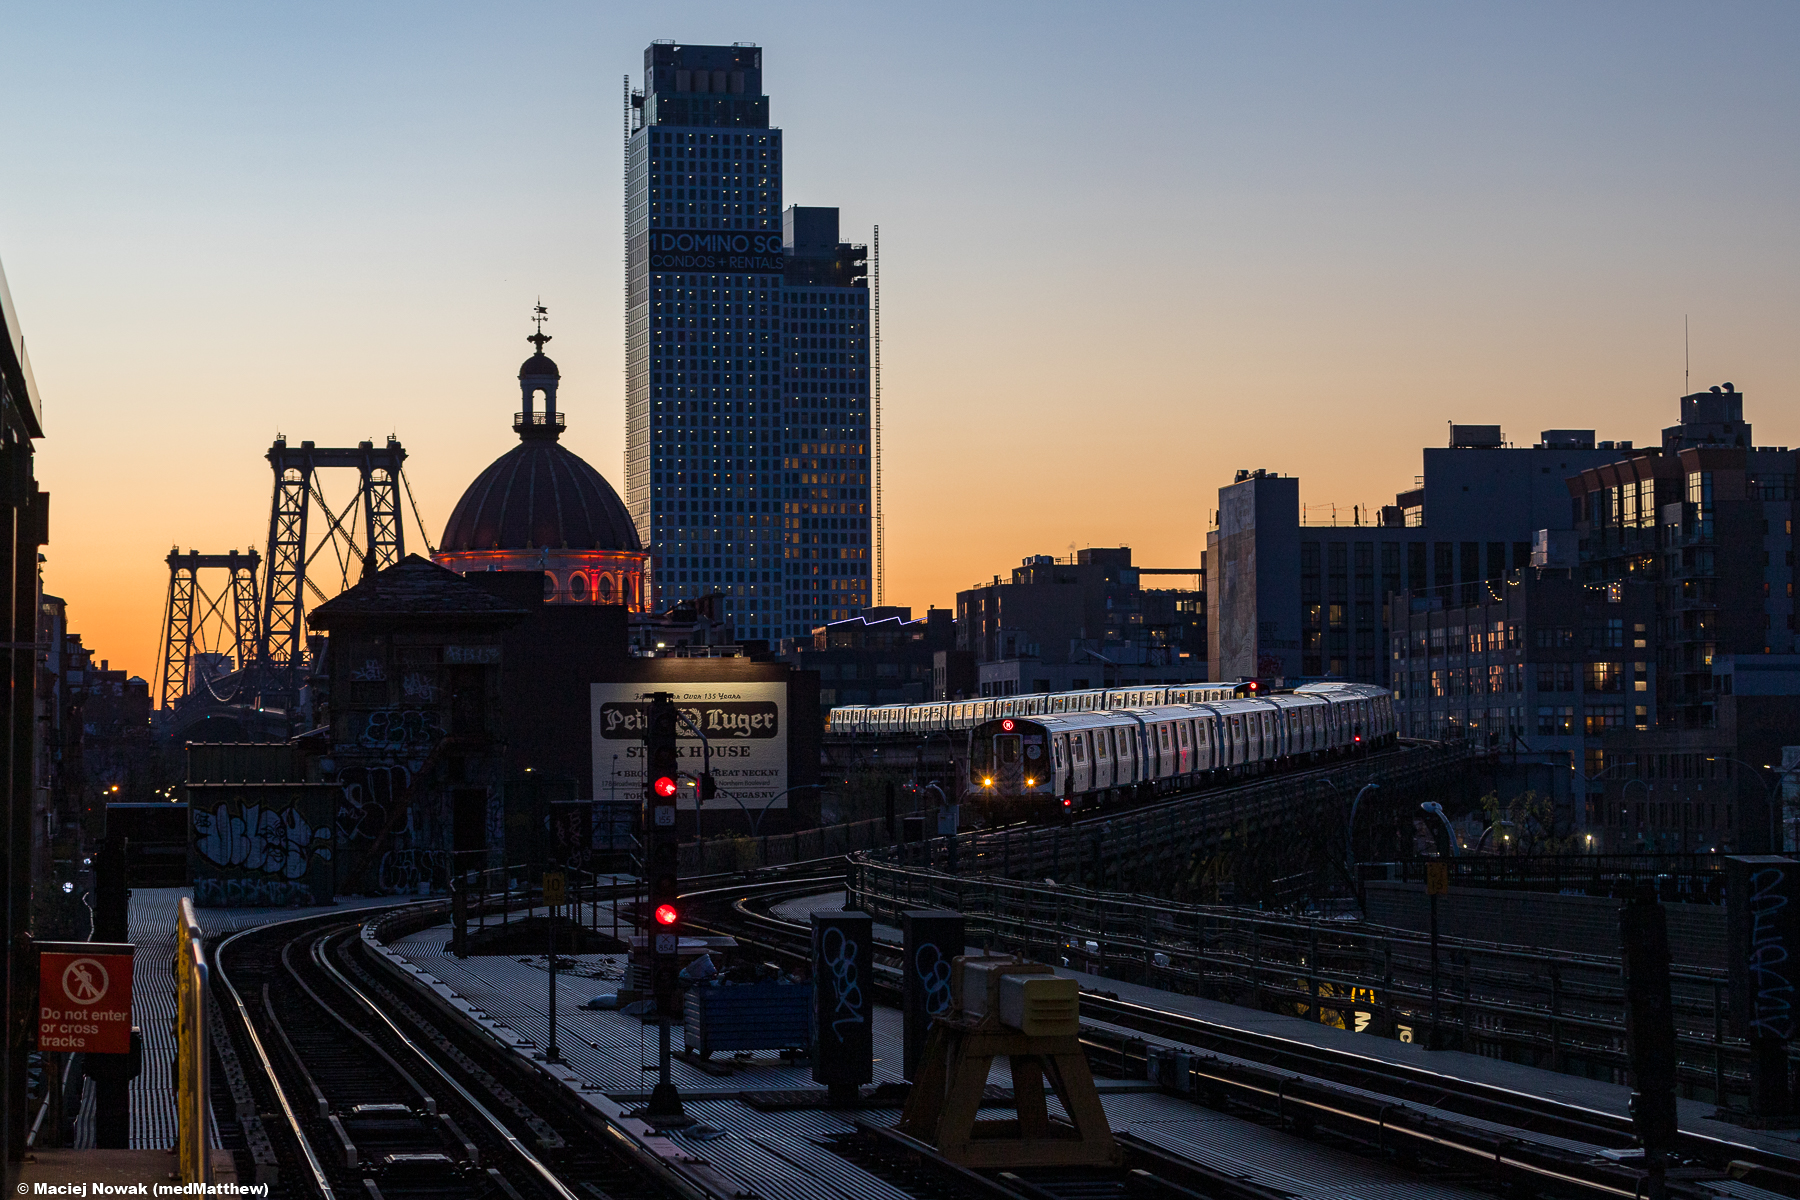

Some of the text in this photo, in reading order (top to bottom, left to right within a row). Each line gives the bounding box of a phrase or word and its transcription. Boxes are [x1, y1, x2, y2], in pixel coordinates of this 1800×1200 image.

[661, 233, 750, 253] DOMINO
[754, 235, 783, 254] SQ
[651, 254, 715, 268] CONDOS
[729, 256, 784, 269] RENTALS
[603, 708, 775, 737] Pet Luger
[627, 746, 685, 758] STK
[547, 878, 560, 891] 10
[41, 1007, 128, 1022] Do not enter
[41, 1023, 99, 1034] or cross
[41, 1035, 85, 1048] tracks
